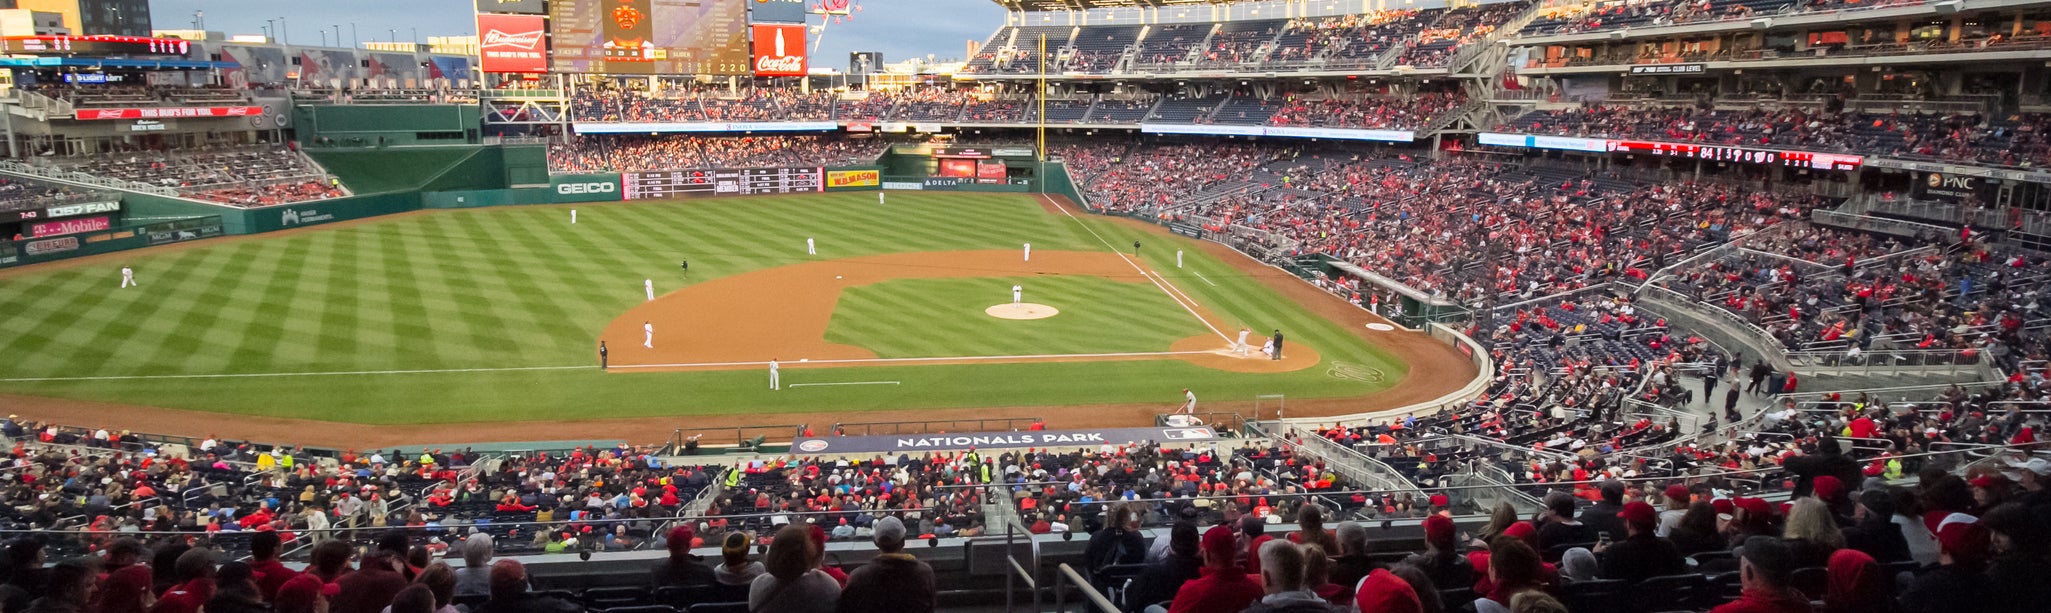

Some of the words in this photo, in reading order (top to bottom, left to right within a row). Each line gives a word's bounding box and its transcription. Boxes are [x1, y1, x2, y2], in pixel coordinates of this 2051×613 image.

[485, 33, 537, 43] Budweiser
[720, 64, 726, 72] 2
[730, 64, 736, 72] 2
[740, 64, 746, 72] 0
[141, 109, 158, 117] THIS
[159, 108, 181, 117] BUD'S
[182, 108, 196, 116] FOR
[1700, 147, 1713, 158] 84
[1726, 148, 1732, 159] 3
[1745, 152, 1752, 161] 0
[1767, 153, 1775, 163] 0
[557, 182, 615, 194] GEICO
[1943, 177, 1975, 190] PNC
[85, 201, 120, 214] FAN
[20, 211, 37, 219] 7:43
[202, 225, 220, 234] MGM
[151, 231, 173, 241] MGM
[897, 434, 1034, 448] NATIONALS
[1043, 432, 1105, 443] PARK
